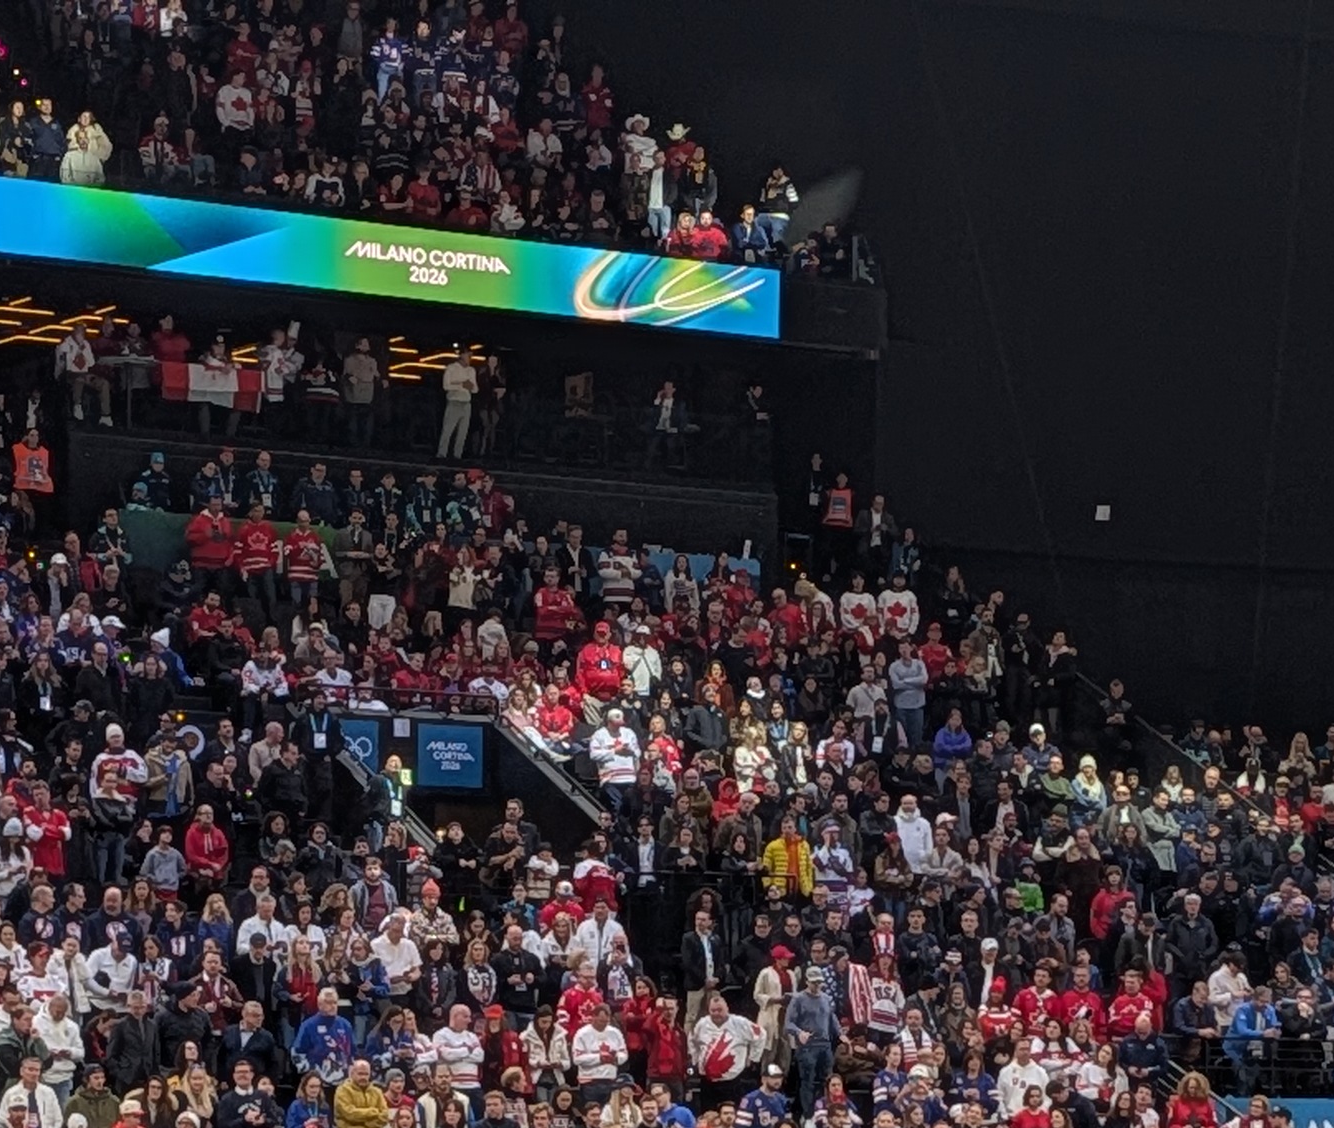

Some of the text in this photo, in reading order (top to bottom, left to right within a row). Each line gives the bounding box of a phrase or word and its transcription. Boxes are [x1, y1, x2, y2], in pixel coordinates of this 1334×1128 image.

[344, 240, 511, 275] MILANO CORTINA
[409, 266, 448, 286] 2026
